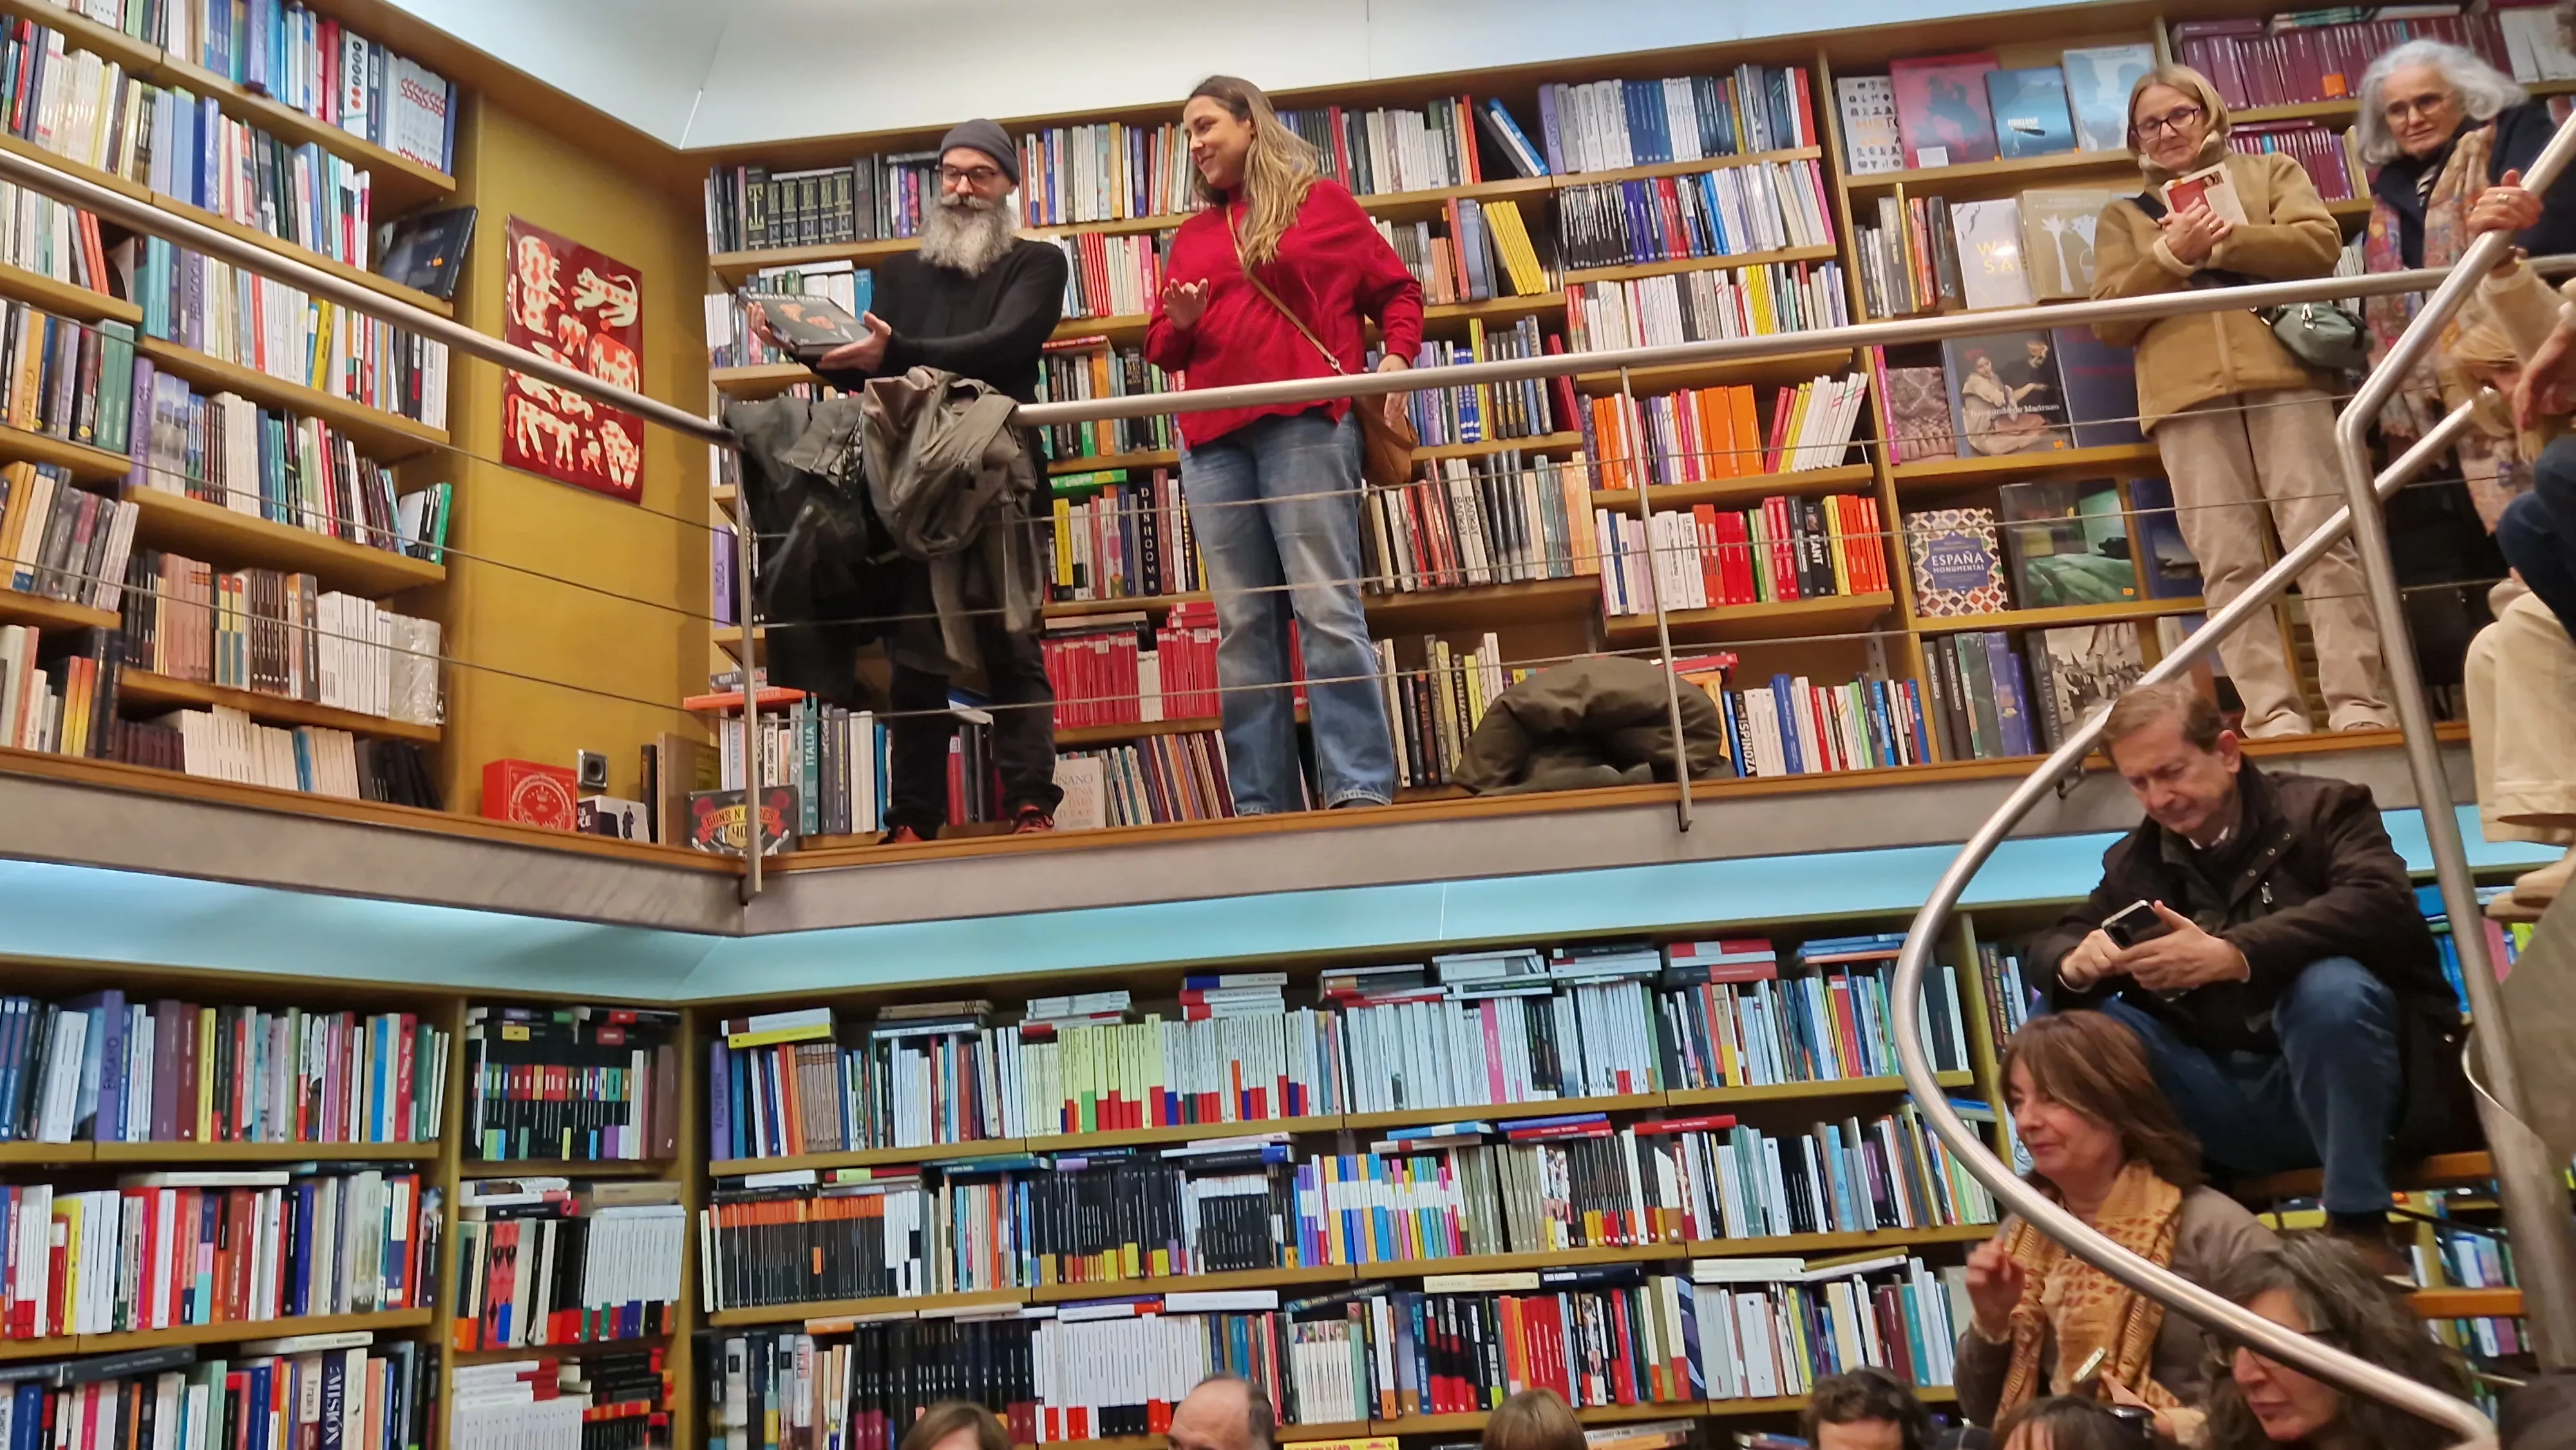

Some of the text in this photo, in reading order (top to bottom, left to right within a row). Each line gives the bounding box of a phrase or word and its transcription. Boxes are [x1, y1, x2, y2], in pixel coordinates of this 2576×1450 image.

[1931, 551, 1984, 566] ESPAÑA
[1933, 564, 1984, 574] MONUMENTAL
[805, 726, 815, 766] ITALIA
[1738, 722, 1757, 774] SPINOZA
[706, 810, 732, 827] GUNS
[326, 1366, 342, 1445] MISIÓN
